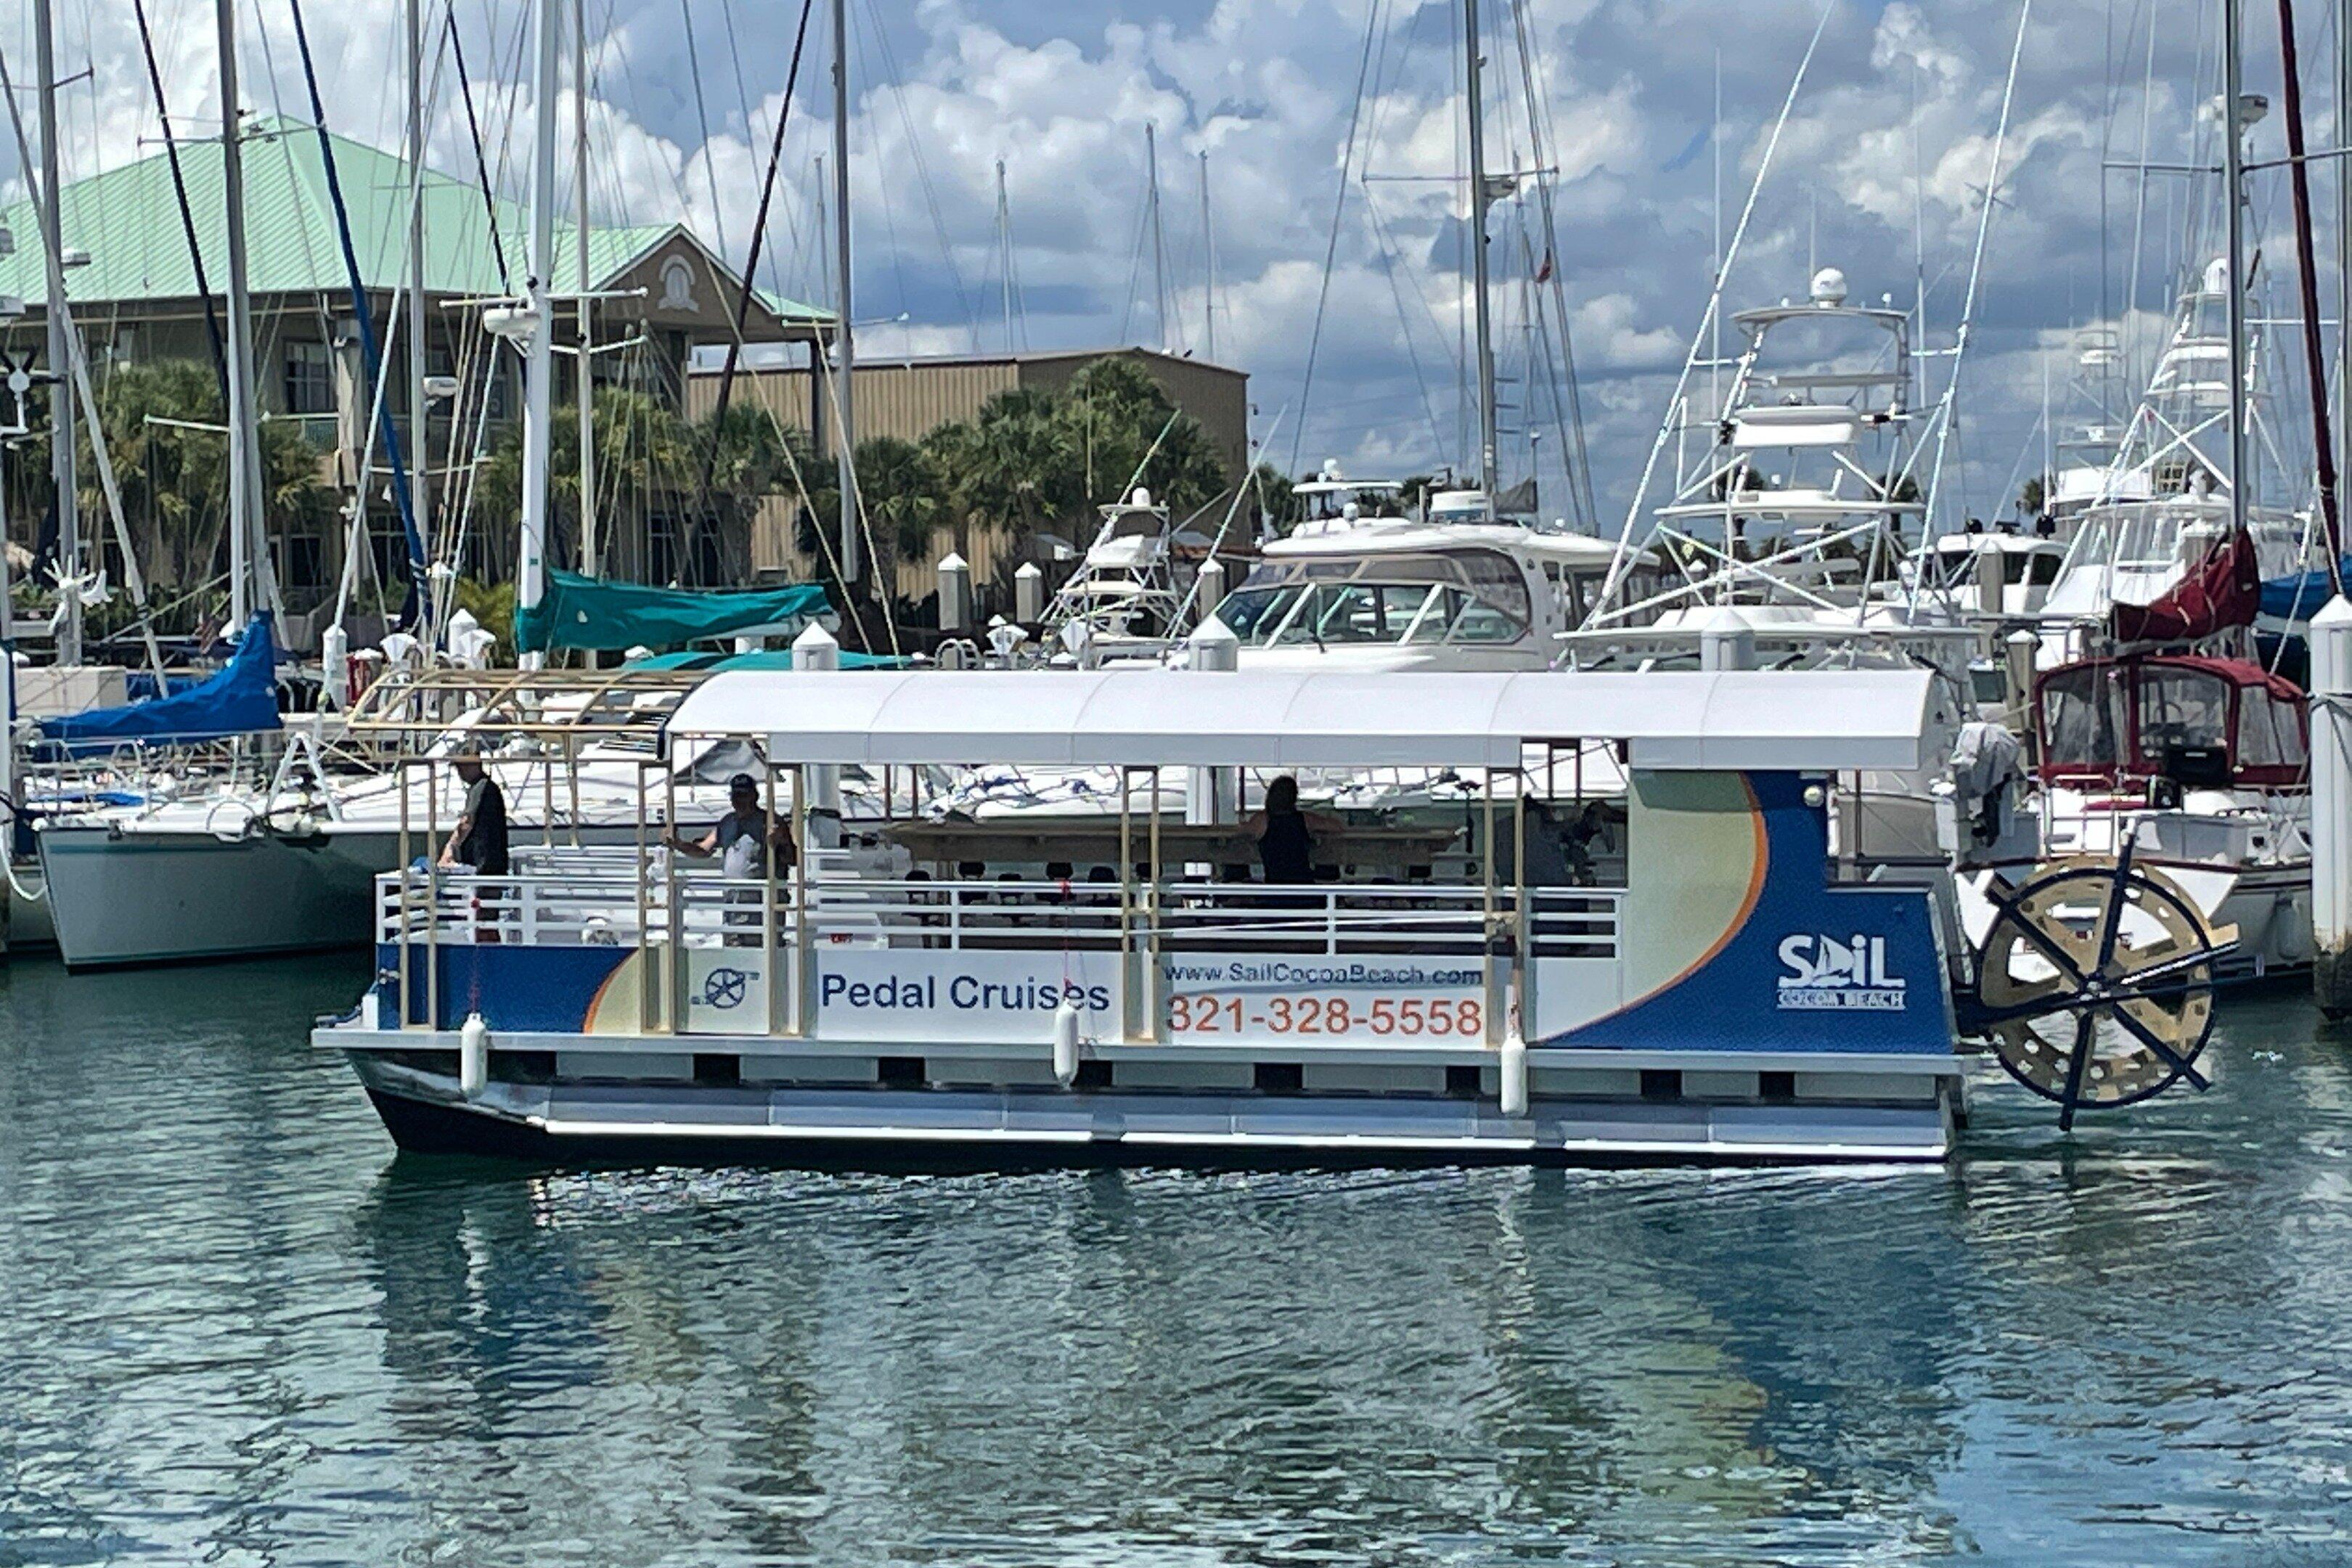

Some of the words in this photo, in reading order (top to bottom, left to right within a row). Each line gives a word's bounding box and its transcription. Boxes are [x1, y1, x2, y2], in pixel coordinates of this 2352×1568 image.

[822, 973, 936, 1010] Pedal
[950, 975, 1110, 1011] Cruises
[1164, 963, 1483, 984] www.SailCocoaBeach.com
[1167, 995, 1482, 1037] 321-328-5558
